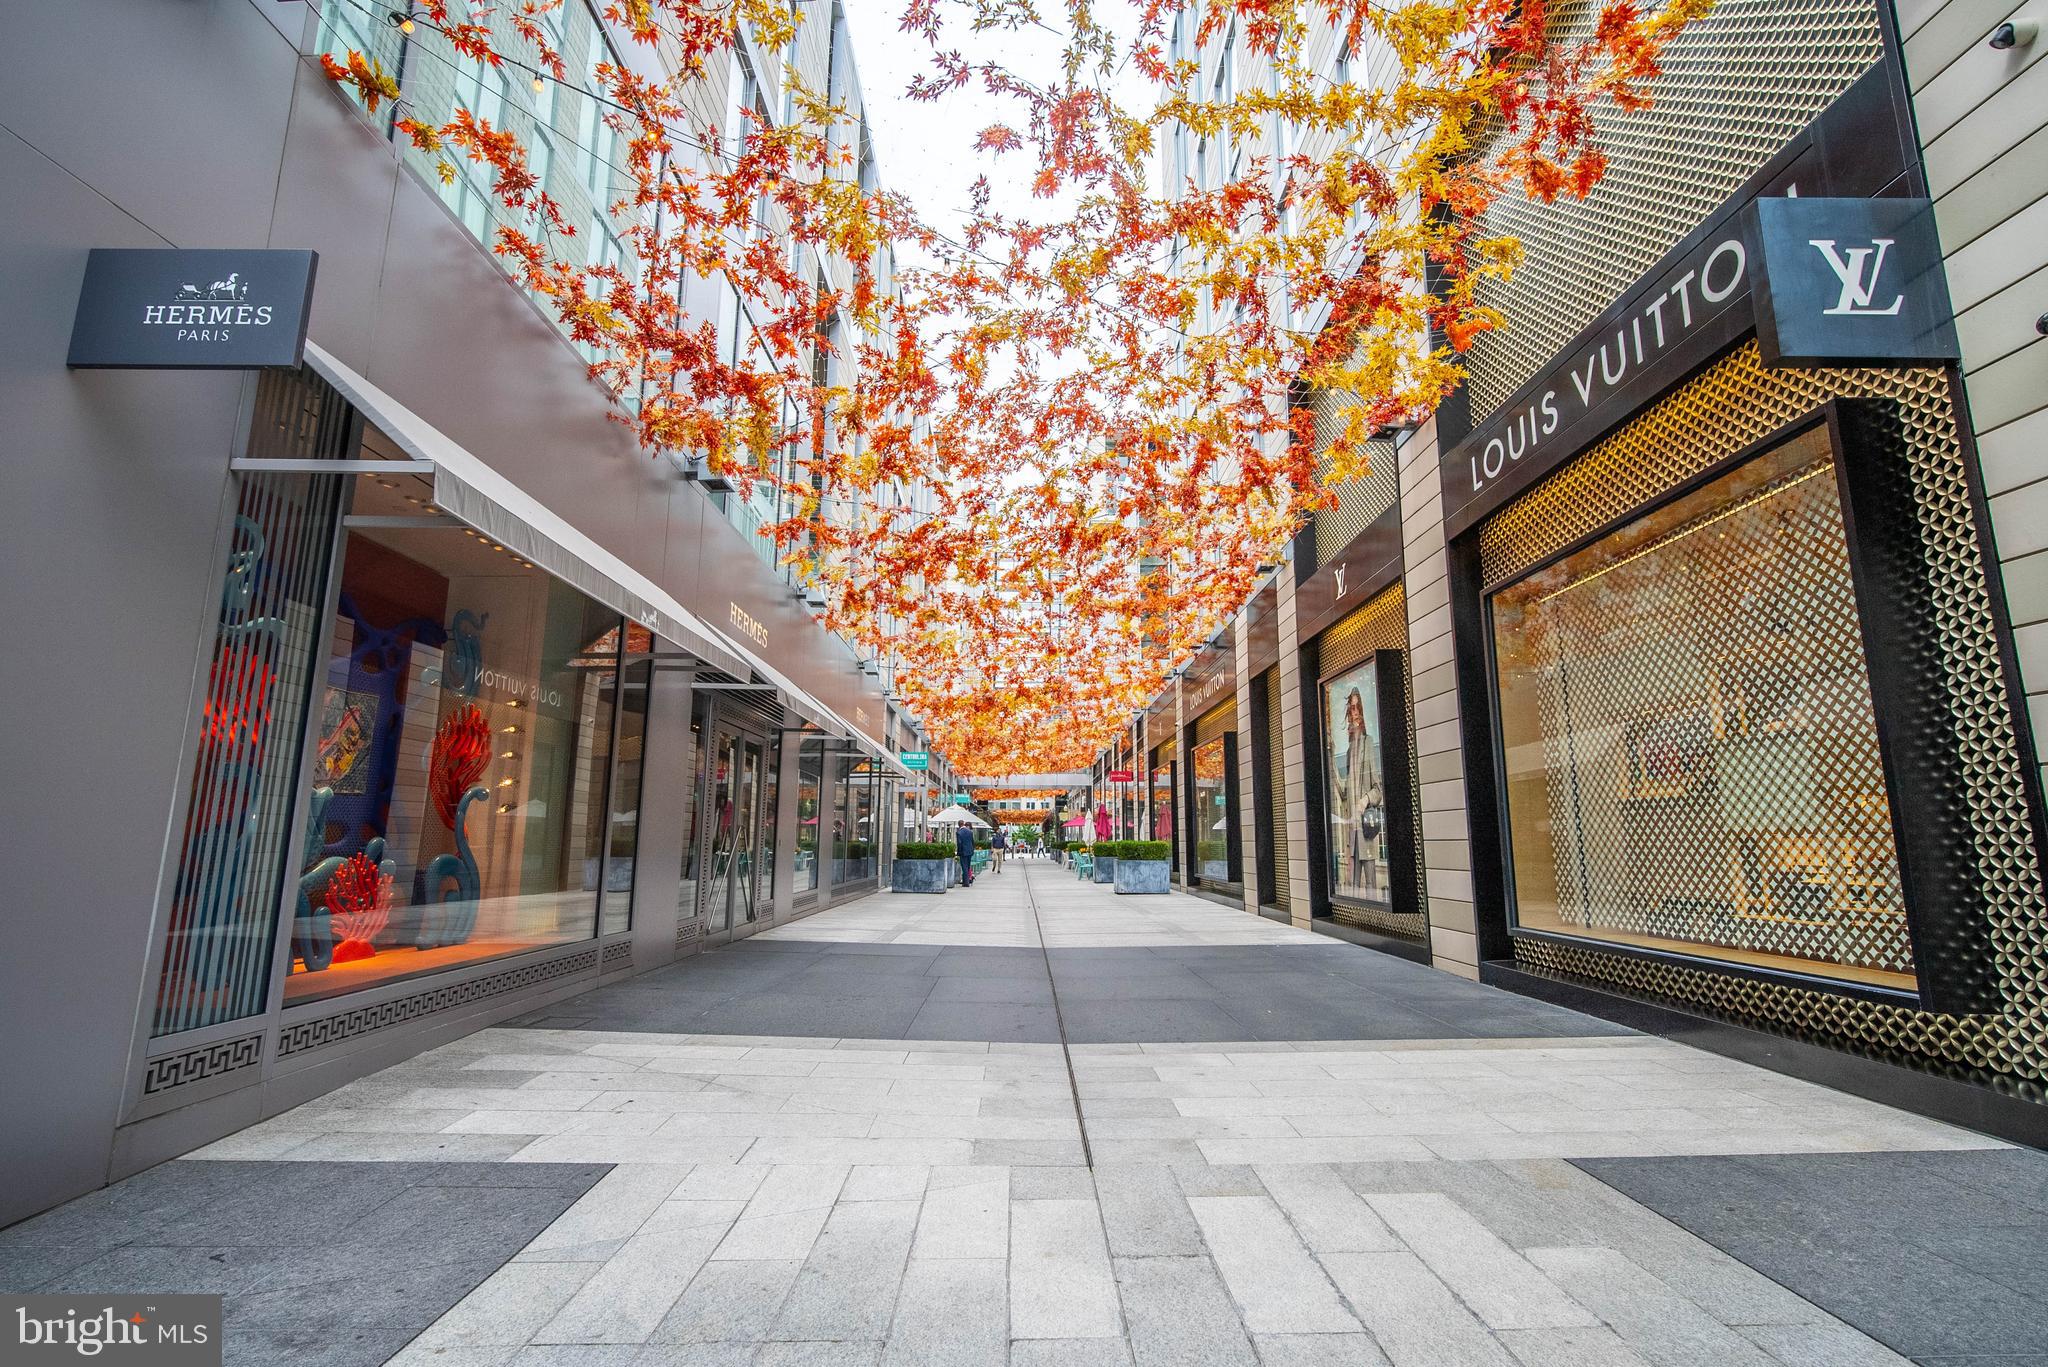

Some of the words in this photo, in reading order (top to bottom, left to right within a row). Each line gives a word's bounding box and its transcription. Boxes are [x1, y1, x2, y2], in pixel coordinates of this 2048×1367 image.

[177, 329, 230, 341] PARIS
[1471, 391, 1559, 491] LOUIS
[1570, 182, 1798, 407] VUITTO
[1190, 688, 1203, 710] LOUIS
[1203, 669, 1225, 699] VUITTON
